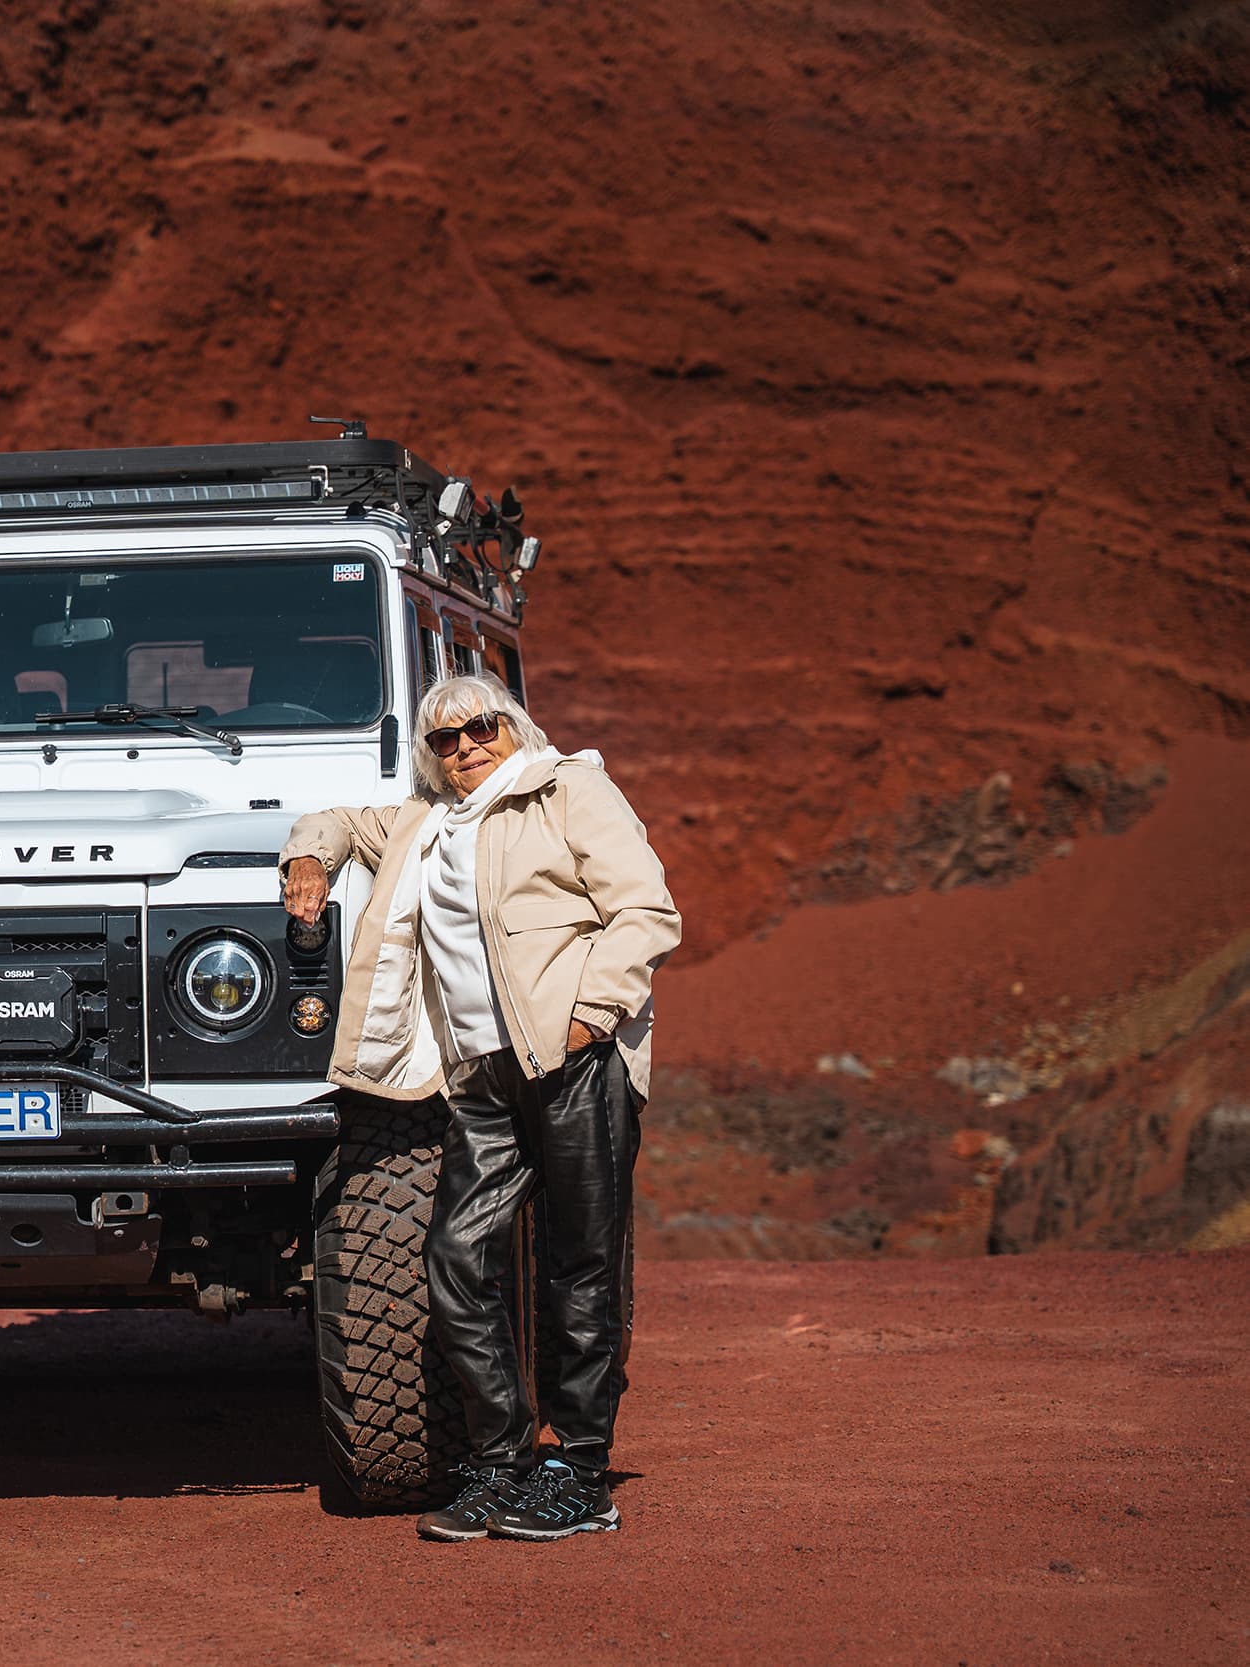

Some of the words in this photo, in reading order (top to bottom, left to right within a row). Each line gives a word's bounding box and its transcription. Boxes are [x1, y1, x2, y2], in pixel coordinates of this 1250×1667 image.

[67, 501, 92, 509] OSRAM
[336, 572, 361, 580] MOLY
[4, 970, 35, 978] OSRAM
